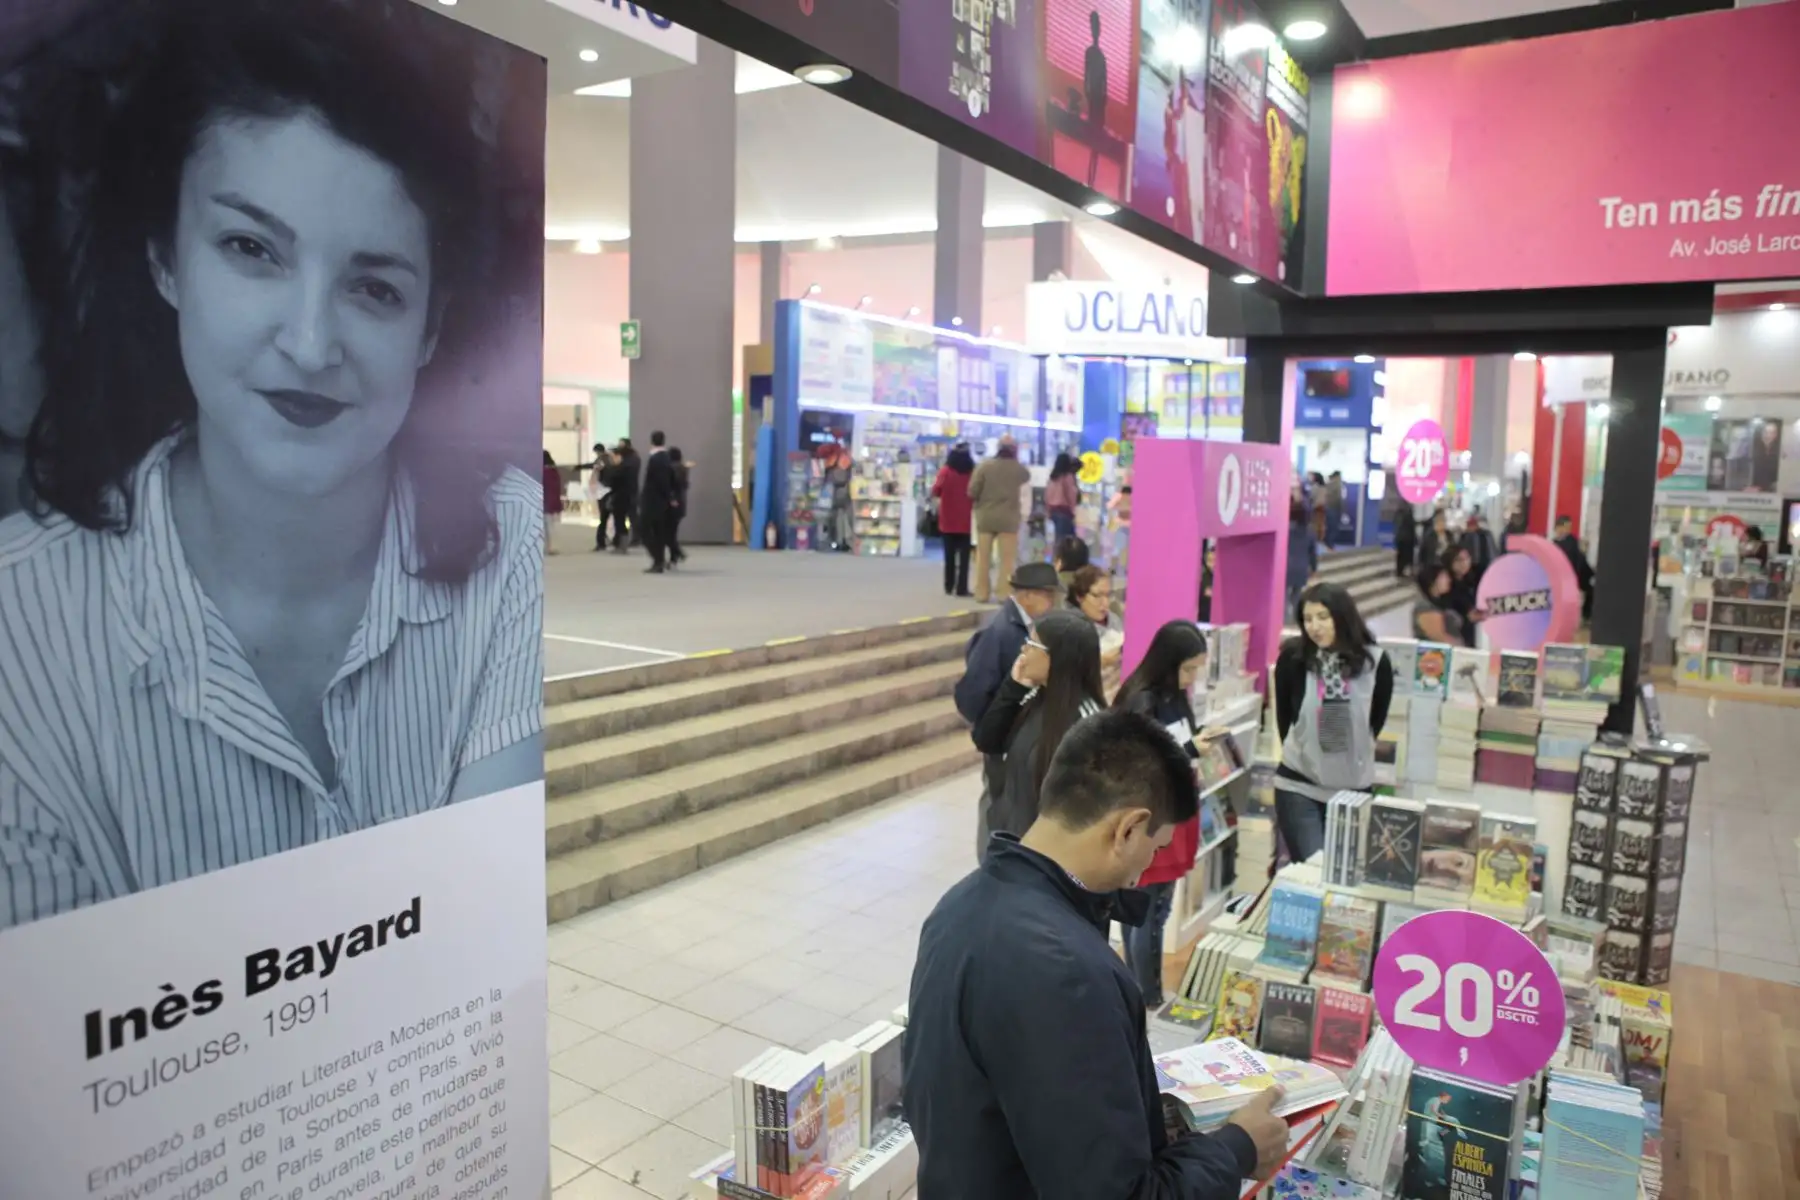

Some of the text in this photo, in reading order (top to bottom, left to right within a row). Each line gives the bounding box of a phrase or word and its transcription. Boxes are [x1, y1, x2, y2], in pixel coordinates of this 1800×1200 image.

[1599, 184, 1800, 229] Ten más fin
[1669, 238, 1698, 258] Av.
[1704, 233, 1751, 256] José
[84, 896, 421, 1061] Inès Bayard
[1394, 954, 1540, 1038] 20%
[1496, 1009, 1540, 1025] DSCTO.
[82, 988, 330, 1114] Toulouse, 1991
[87, 987, 502, 1193] Empezó a estudiar Literatura Moderna en la
[239, 1122, 265, 1145] de
[276, 1078, 357, 1125] Toulouse
[367, 1068, 377, 1087] y
[388, 1028, 455, 1073] continuó
[464, 1020, 482, 1037] en
[490, 1010, 503, 1026] la
[240, 1179, 265, 1200] en
[335, 1118, 381, 1151] antes
[392, 1102, 413, 1121] de
[422, 1064, 487, 1106] mudarse
[495, 1056, 504, 1069] a
[241, 1150, 267, 1172] de
[279, 1135, 295, 1153] la
[306, 1092, 380, 1139] Sorbona
[390, 1078, 410, 1097] en
[470, 1030, 504, 1057] Vivió
[308, 1146, 375, 1193] durante
[380, 1126, 414, 1153] este
[479, 1078, 505, 1102] que
[394, 1150, 415, 1172] Le
[422, 1113, 480, 1155] malheur
[488, 1099, 506, 1118] du
[426, 1157, 445, 1177] de
[455, 1136, 482, 1160] que
[491, 1121, 507, 1139] su
[455, 1141, 508, 1182] obtener
